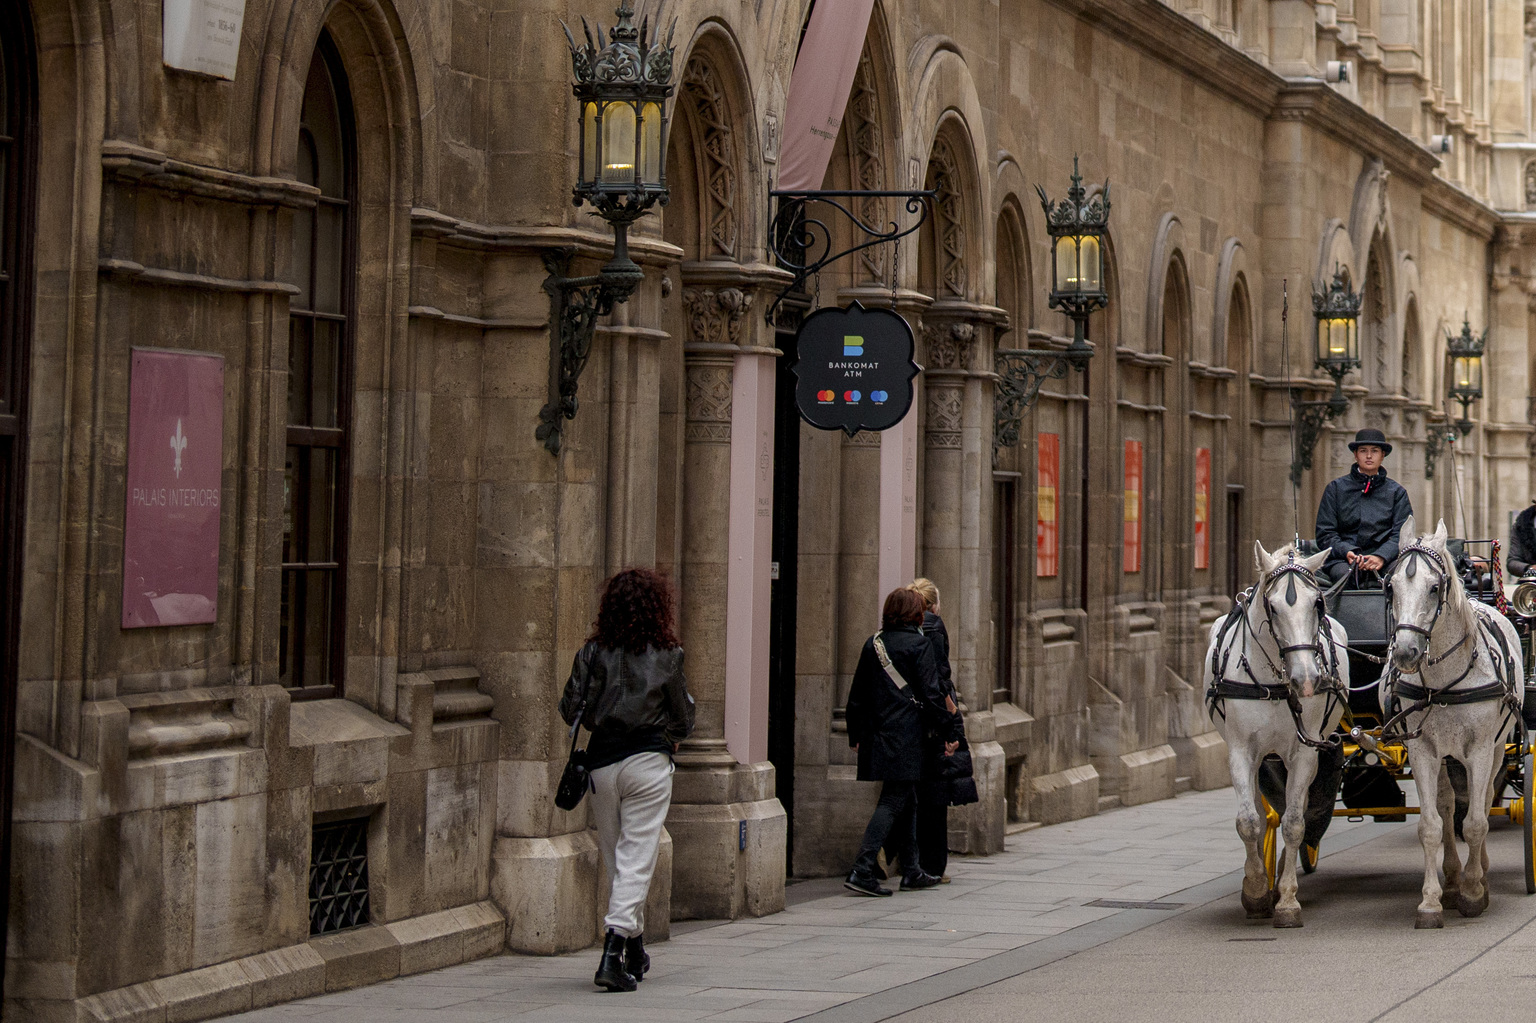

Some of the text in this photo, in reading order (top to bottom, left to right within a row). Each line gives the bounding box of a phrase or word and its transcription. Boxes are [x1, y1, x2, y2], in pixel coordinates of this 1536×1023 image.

[828, 361, 879, 370] BANKOMAT
[132, 488, 219, 507] PALAIS INTERIORS
